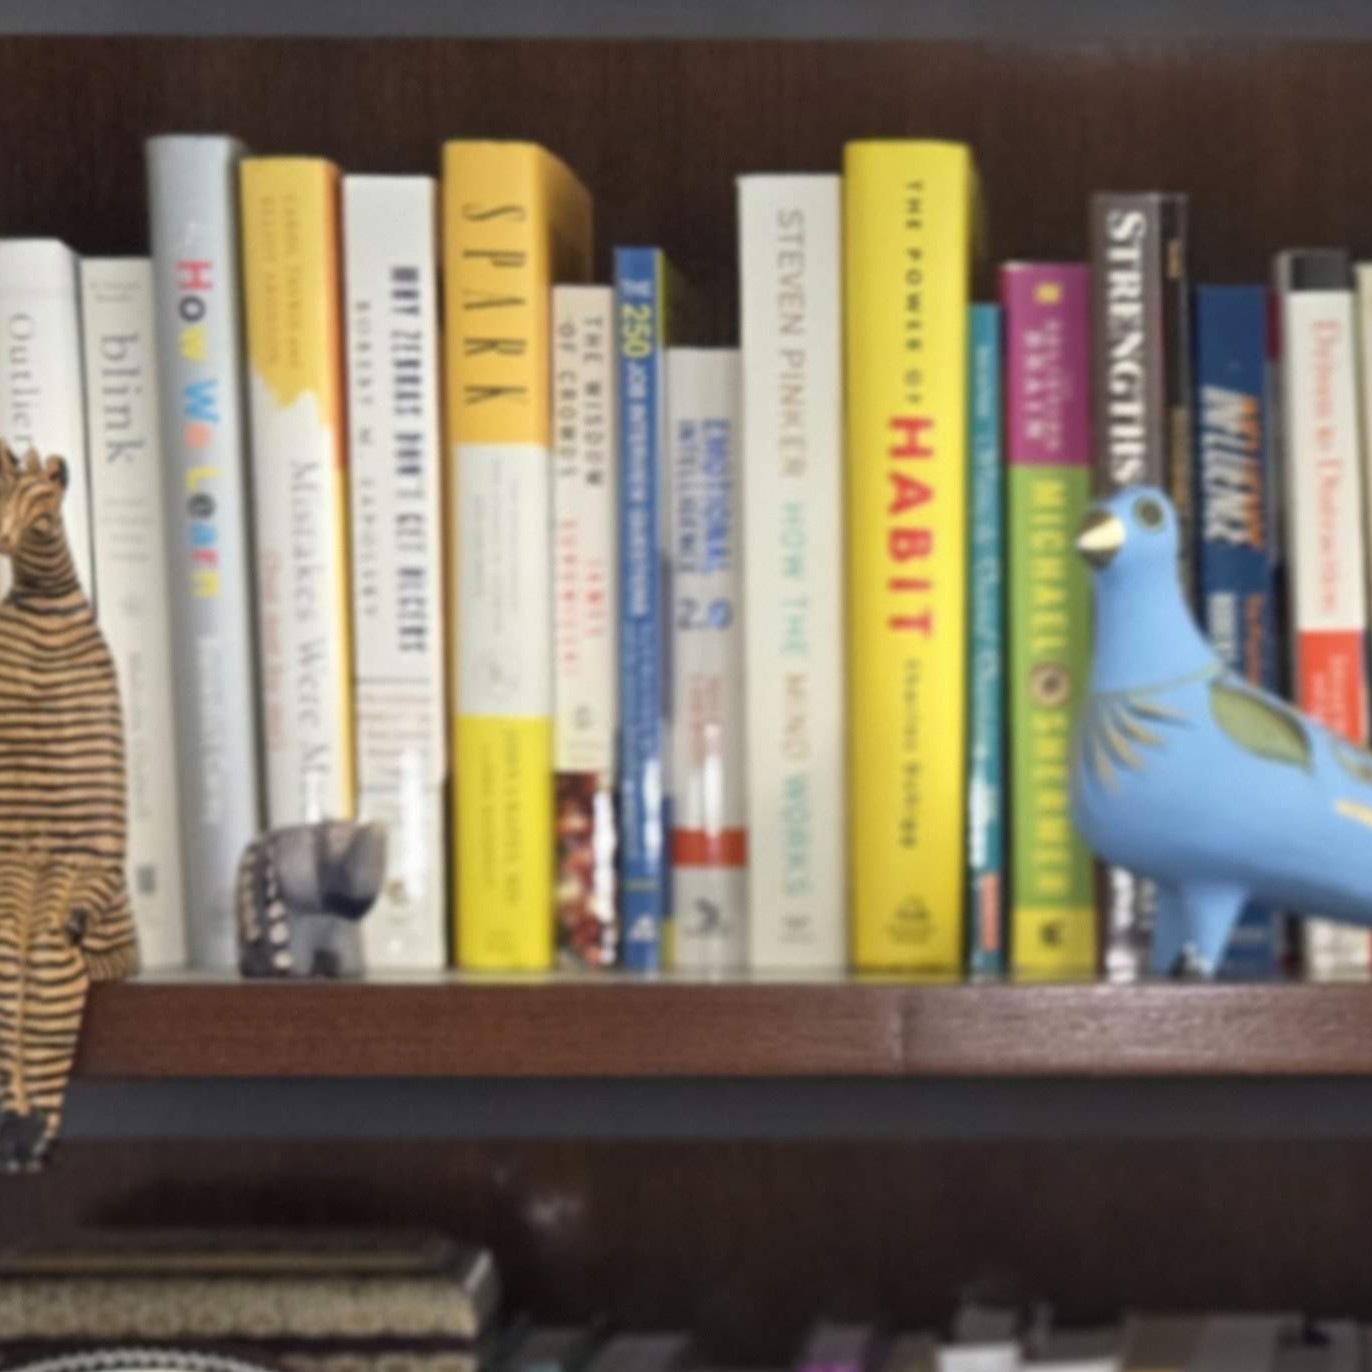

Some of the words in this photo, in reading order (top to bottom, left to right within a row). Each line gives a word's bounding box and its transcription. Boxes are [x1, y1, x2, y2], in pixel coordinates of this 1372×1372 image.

[904, 179, 925, 231] THE
[175, 259, 214, 362] How
[389, 267, 421, 316] WHY
[460, 204, 528, 406] SPARK
[776, 208, 807, 337] STEVEN
[903, 247, 925, 351] POWER
[354, 301, 374, 406] ROBERT
[391, 329, 423, 416] ZEBRAS
[557, 322, 576, 353] OF
[584, 316, 604, 362] THE
[621, 303, 652, 359] 250
[627, 362, 648, 399] JOB
[1108, 209, 1147, 484] STRENGTHS
[1311, 320, 1343, 420] Driven
[6, 311, 42, 462] Outlier
[99, 334, 146, 465] blink
[184, 379, 220, 448] We
[558, 370, 579, 479] CROWDS
[584, 383, 605, 486] WISDOM
[778, 351, 807, 479] PINKER
[903, 368, 923, 405] OF
[393, 433, 424, 501] DON'T
[628, 404, 650, 500] INTERVIEW
[1201, 384, 1265, 550] INFLUENCE
[185, 466, 222, 598] Learn
[290, 462, 326, 623] Mistakes
[395, 514, 425, 552] GET
[629, 508, 652, 617] QUESTIONS
[780, 502, 808, 578] HOW
[886, 415, 936, 637] HABIT
[1031, 480, 1067, 653] MICHAEL
[397, 567, 428, 654] ULCERS
[297, 638, 329, 730] Were
